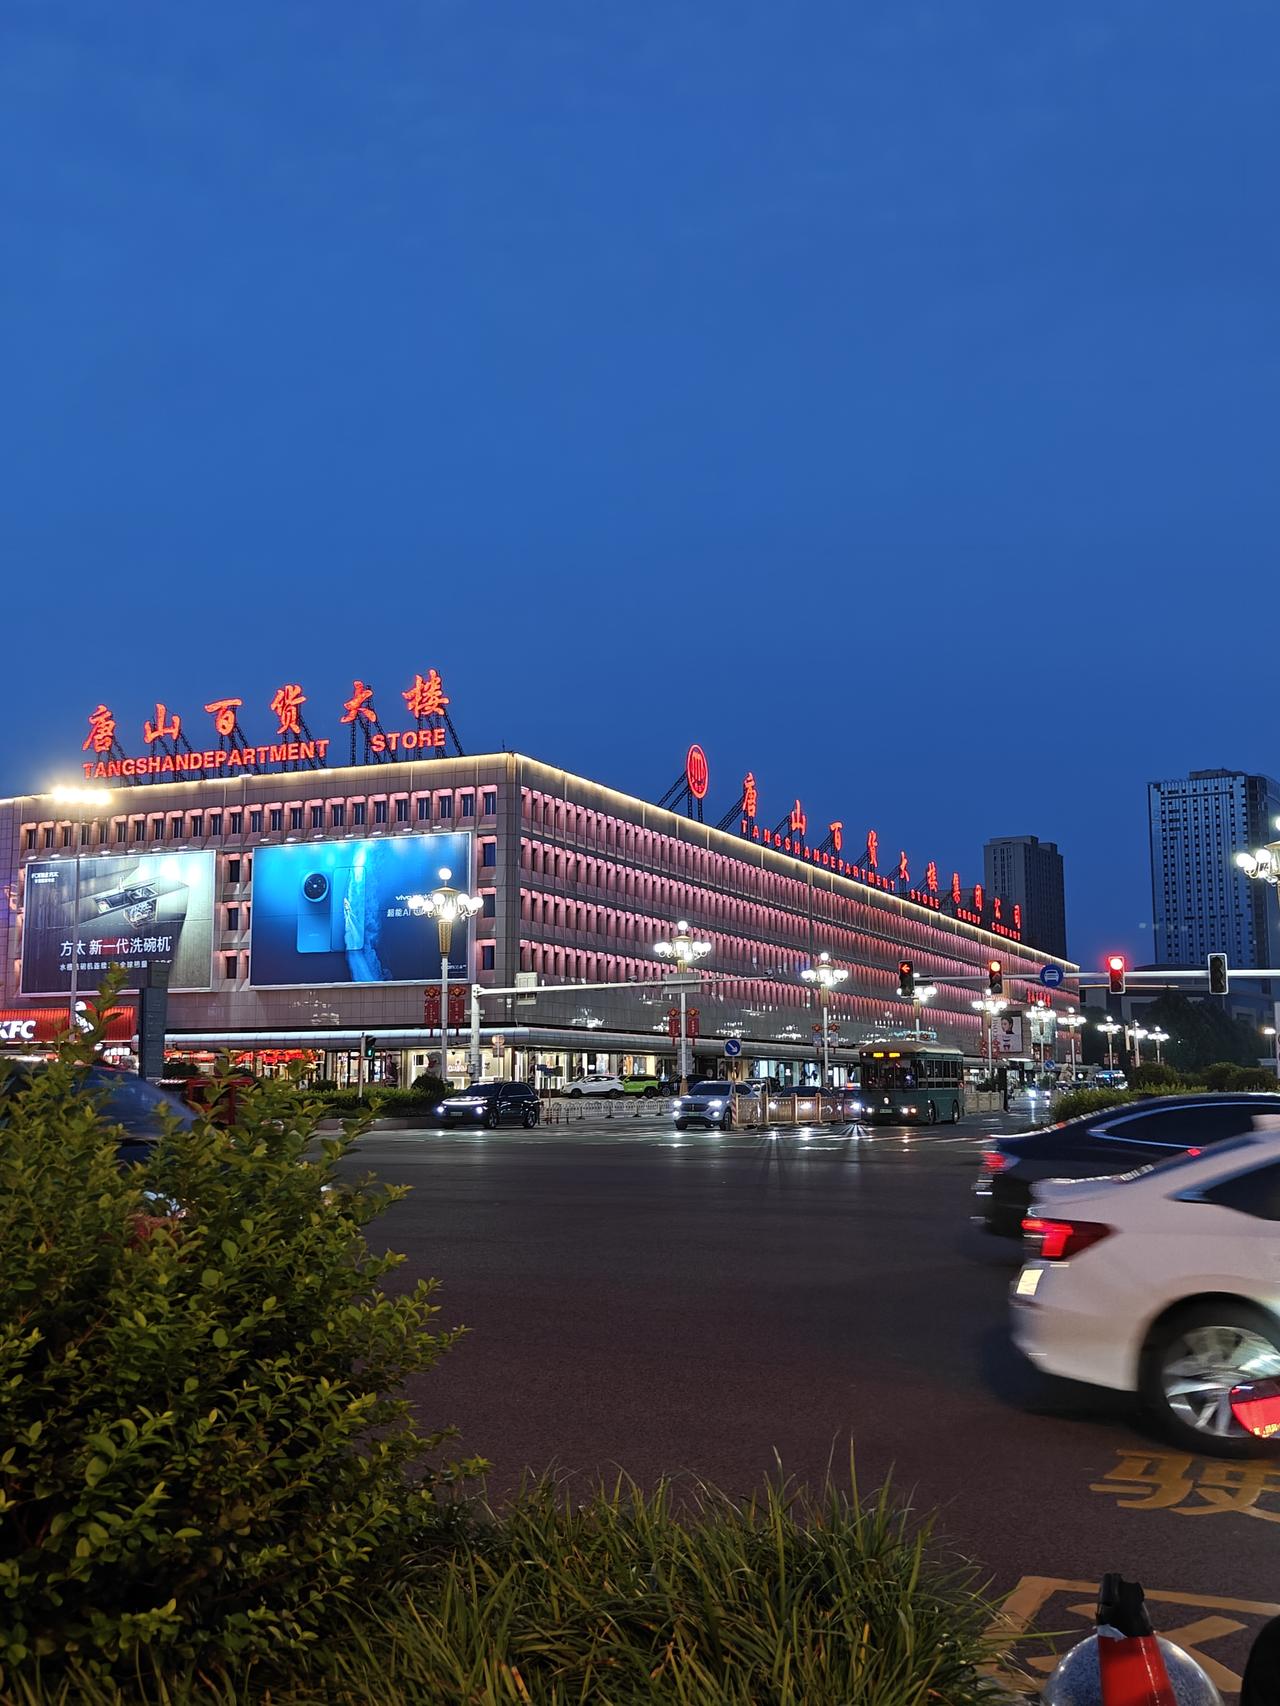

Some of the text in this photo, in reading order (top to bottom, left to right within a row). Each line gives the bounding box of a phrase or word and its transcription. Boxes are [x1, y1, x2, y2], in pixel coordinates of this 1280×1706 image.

[82, 668, 450, 753] 唐山百货大楼
[82, 728, 446, 779] TANGSHANDEPARTMENT STORE
[910, 889, 940, 909] STORE
